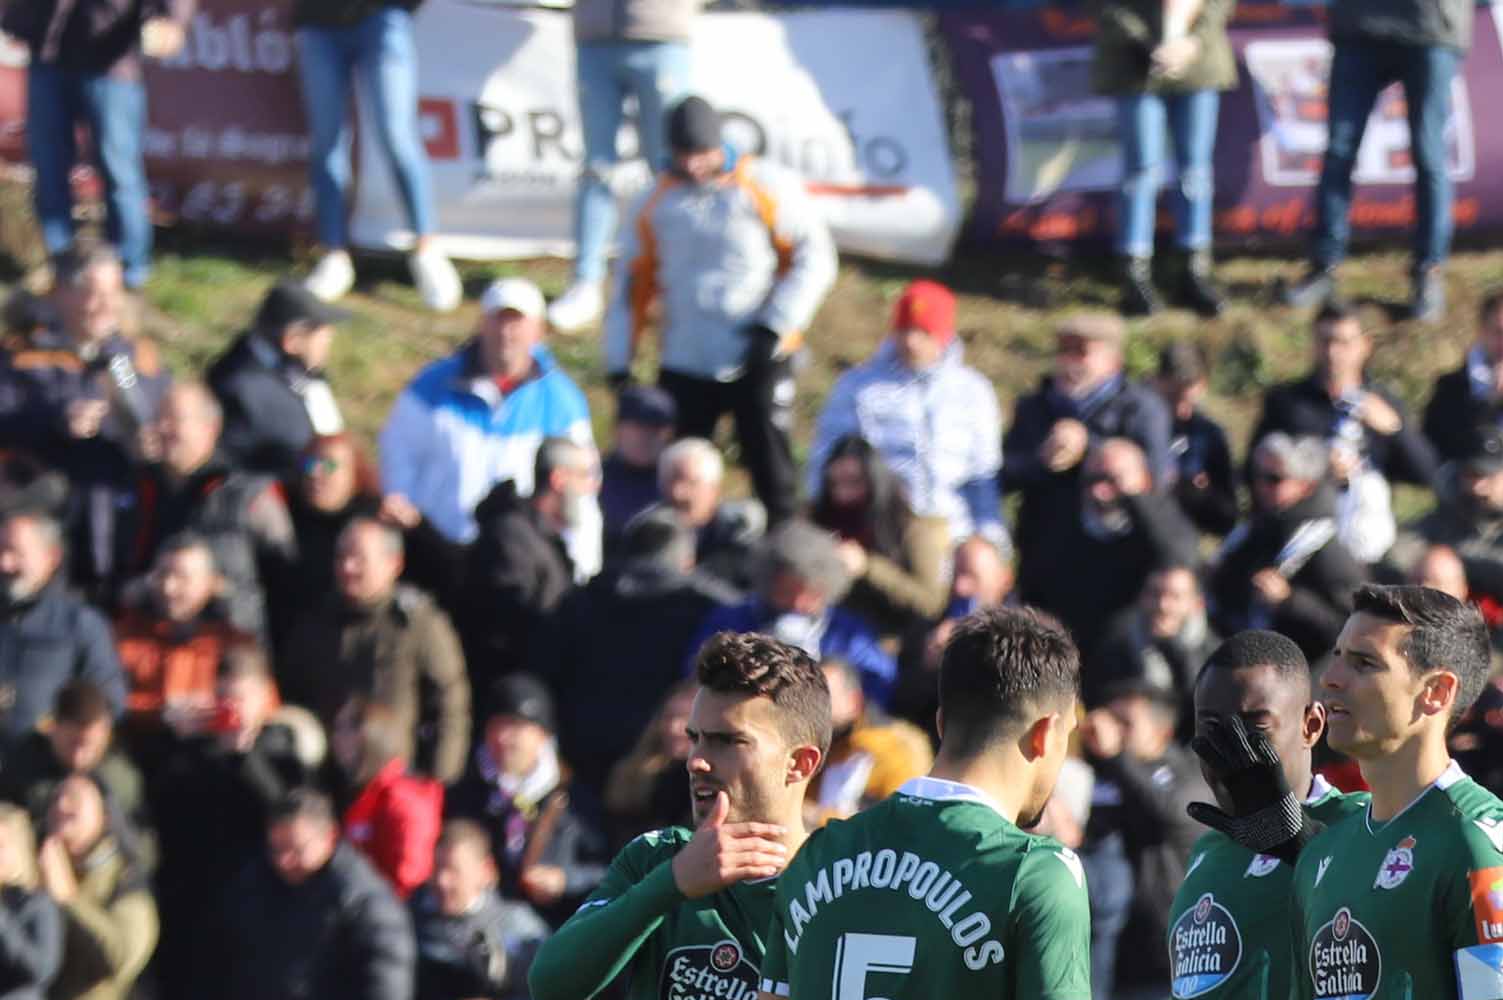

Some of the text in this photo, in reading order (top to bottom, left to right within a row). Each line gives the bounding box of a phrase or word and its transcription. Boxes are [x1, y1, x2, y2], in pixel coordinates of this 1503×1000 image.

[783, 848, 1006, 972] LAMPROPOULOS
[1175, 920, 1227, 952] Estrella
[1174, 947, 1222, 978] Galicia
[1315, 942, 1368, 969] Estrella
[1314, 964, 1364, 997] Galicia
